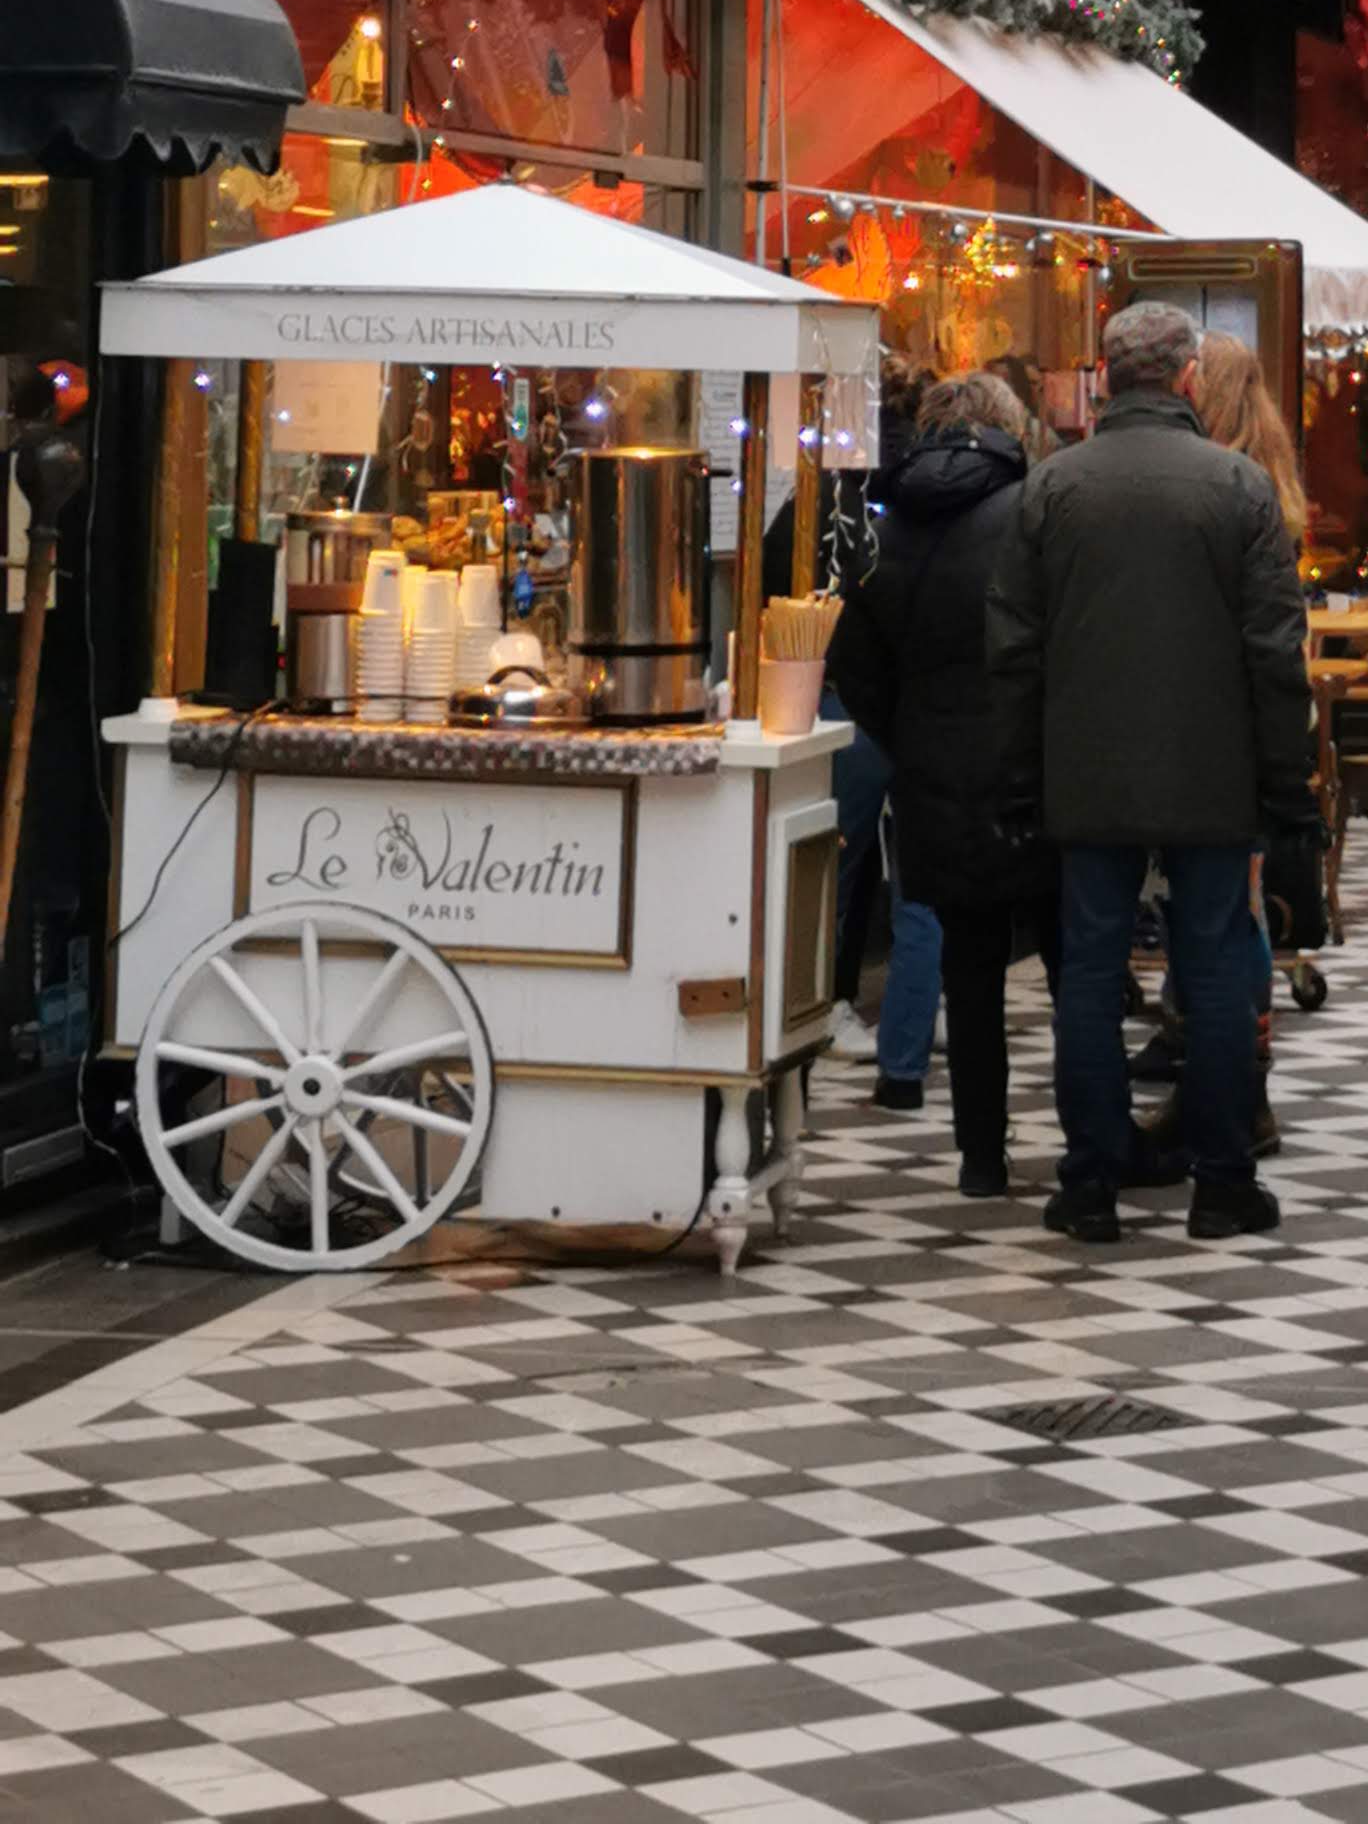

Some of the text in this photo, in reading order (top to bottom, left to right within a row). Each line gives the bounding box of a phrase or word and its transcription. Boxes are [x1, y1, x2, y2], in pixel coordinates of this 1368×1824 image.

[277, 312, 616, 351] GLACES ARTISANALES
[266, 806, 604, 897] Le Valentin
[408, 903, 477, 921] PARIS
